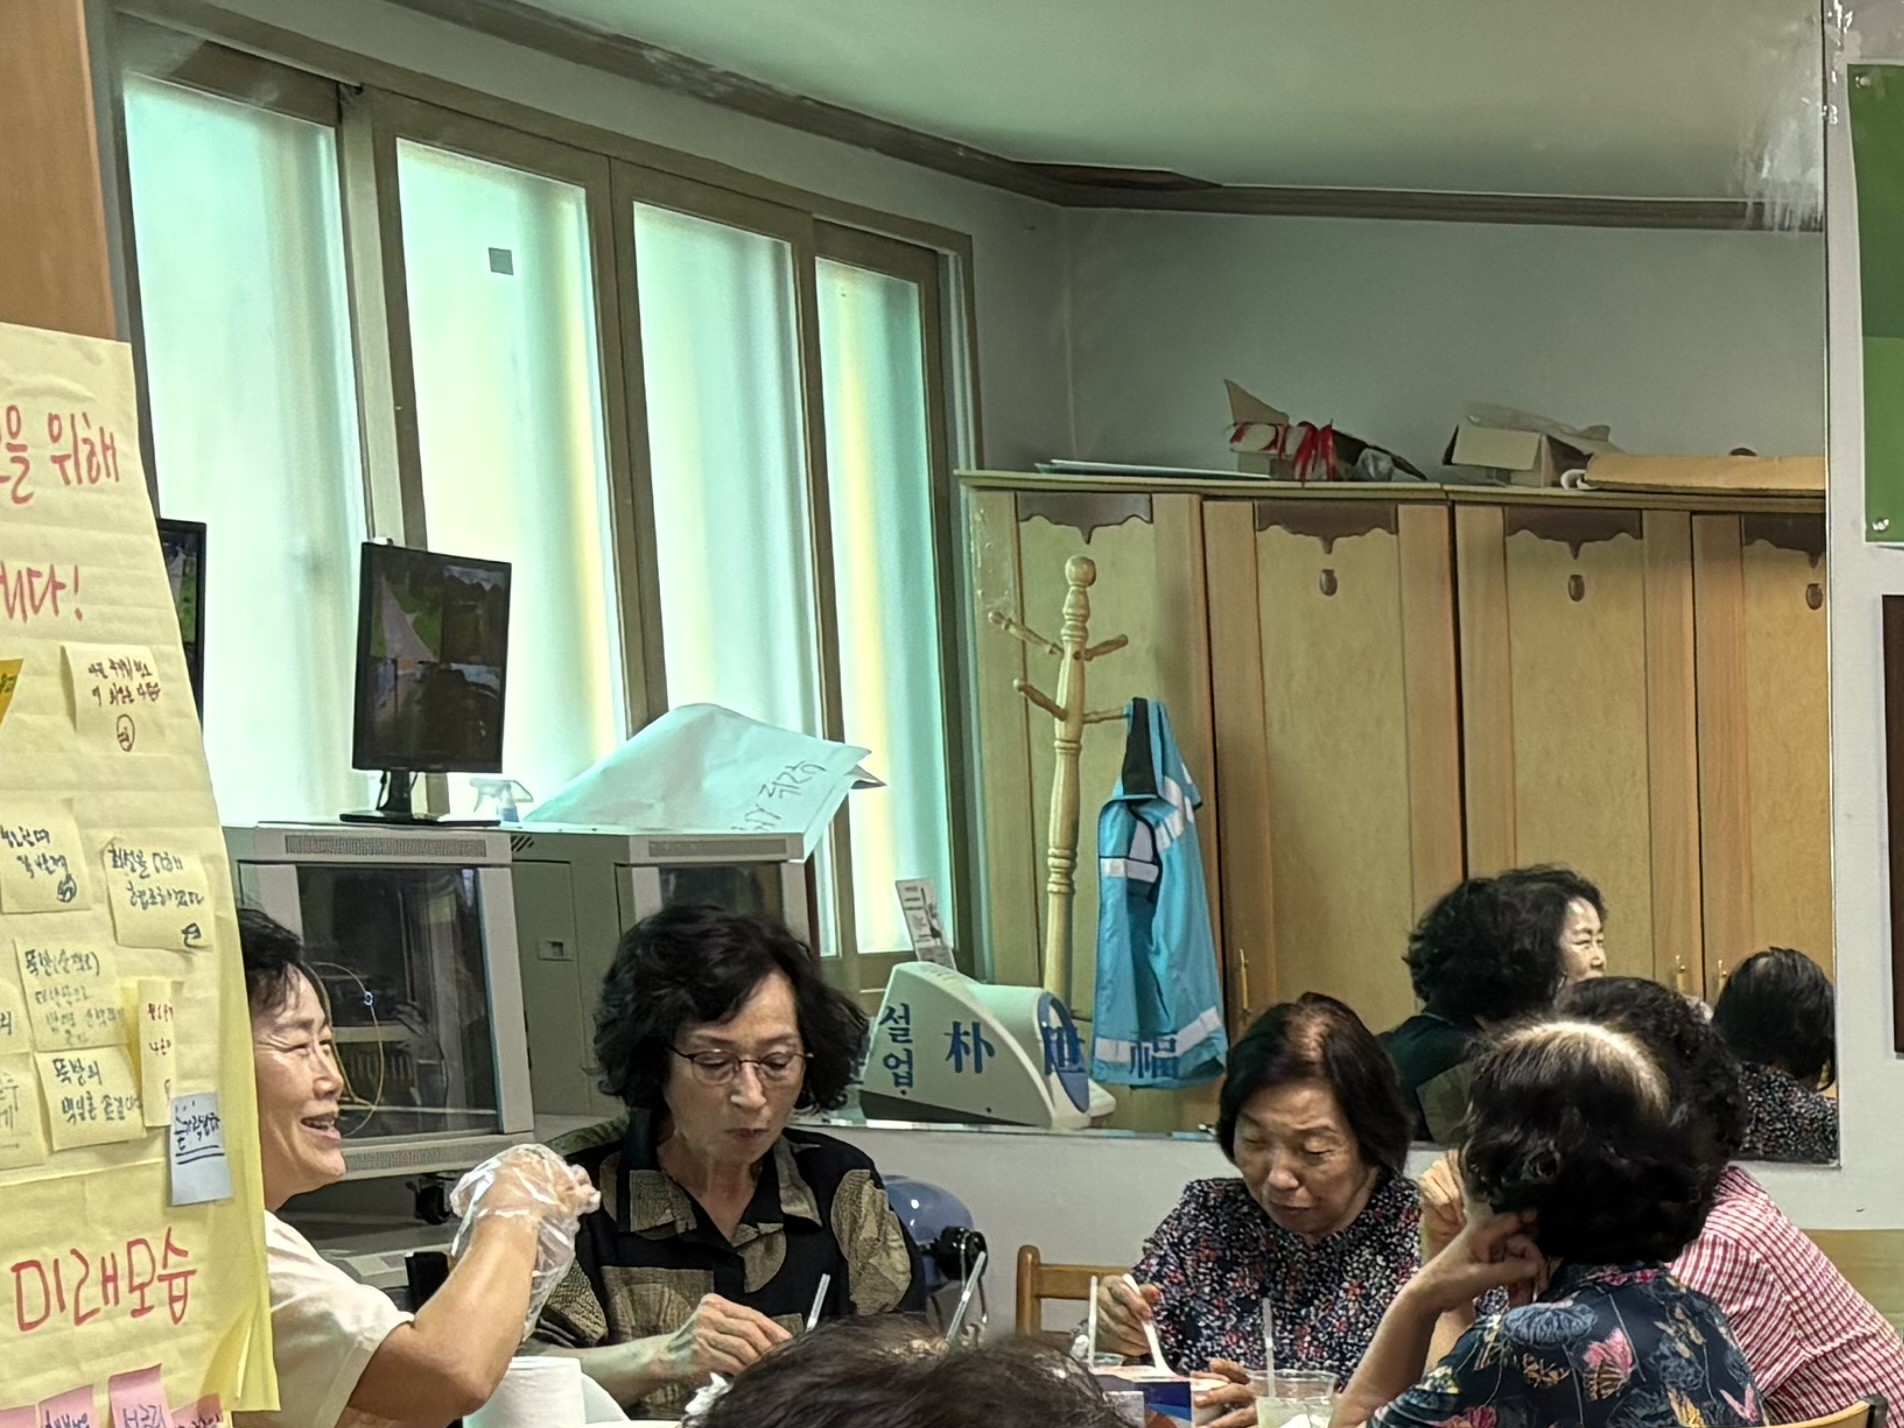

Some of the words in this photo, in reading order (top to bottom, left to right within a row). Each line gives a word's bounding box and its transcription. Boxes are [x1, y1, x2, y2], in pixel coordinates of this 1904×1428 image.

[0, 404, 35, 504] 을
[47, 411, 119, 487] 위해
[0, 560, 84, 624] 니다!
[10, 1226, 198, 1333] 미래모습
